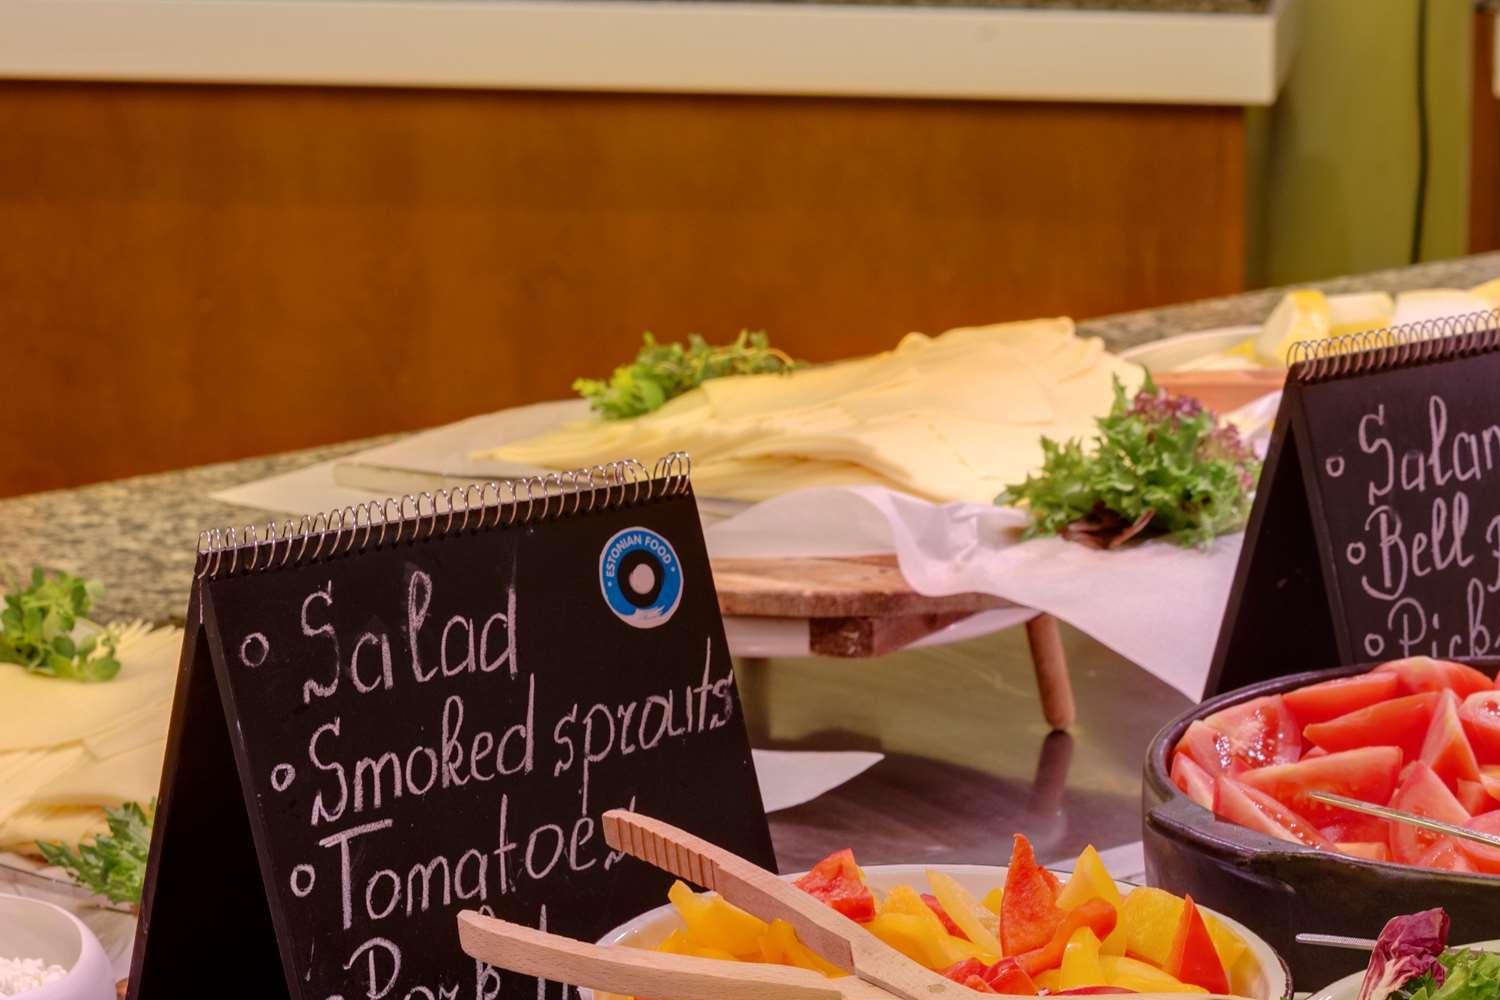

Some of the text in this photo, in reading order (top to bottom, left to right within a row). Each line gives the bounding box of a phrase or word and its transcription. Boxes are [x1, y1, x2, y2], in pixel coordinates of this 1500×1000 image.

[606, 534, 672, 577] ESTONIAN FOOD
[1362, 491, 1475, 601] Bell
[300, 570, 518, 704] Salad
[308, 636, 735, 826] Smoked sprouts
